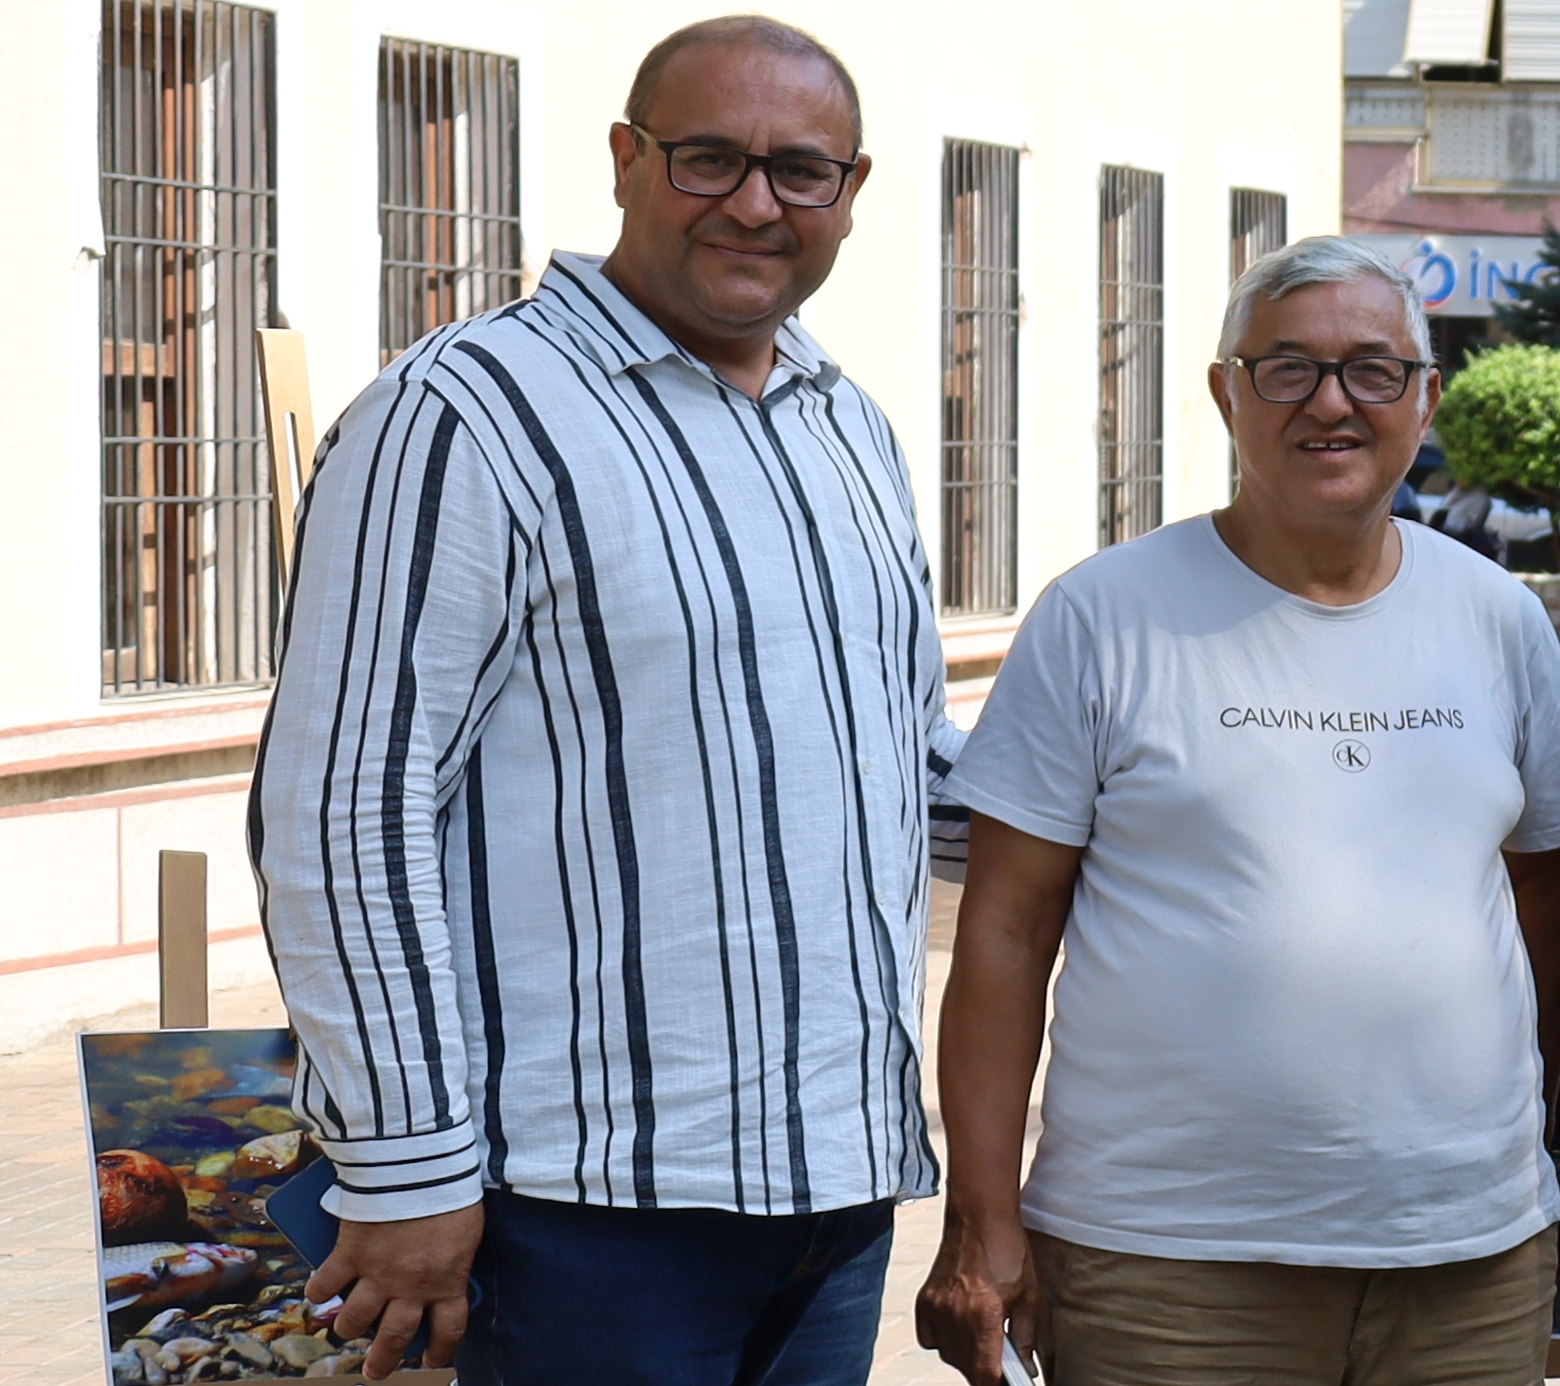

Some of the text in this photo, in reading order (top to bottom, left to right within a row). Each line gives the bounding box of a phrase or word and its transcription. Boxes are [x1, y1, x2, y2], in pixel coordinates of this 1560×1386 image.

[1220, 708, 1464, 732] CALVIN KLEIN JEANS
